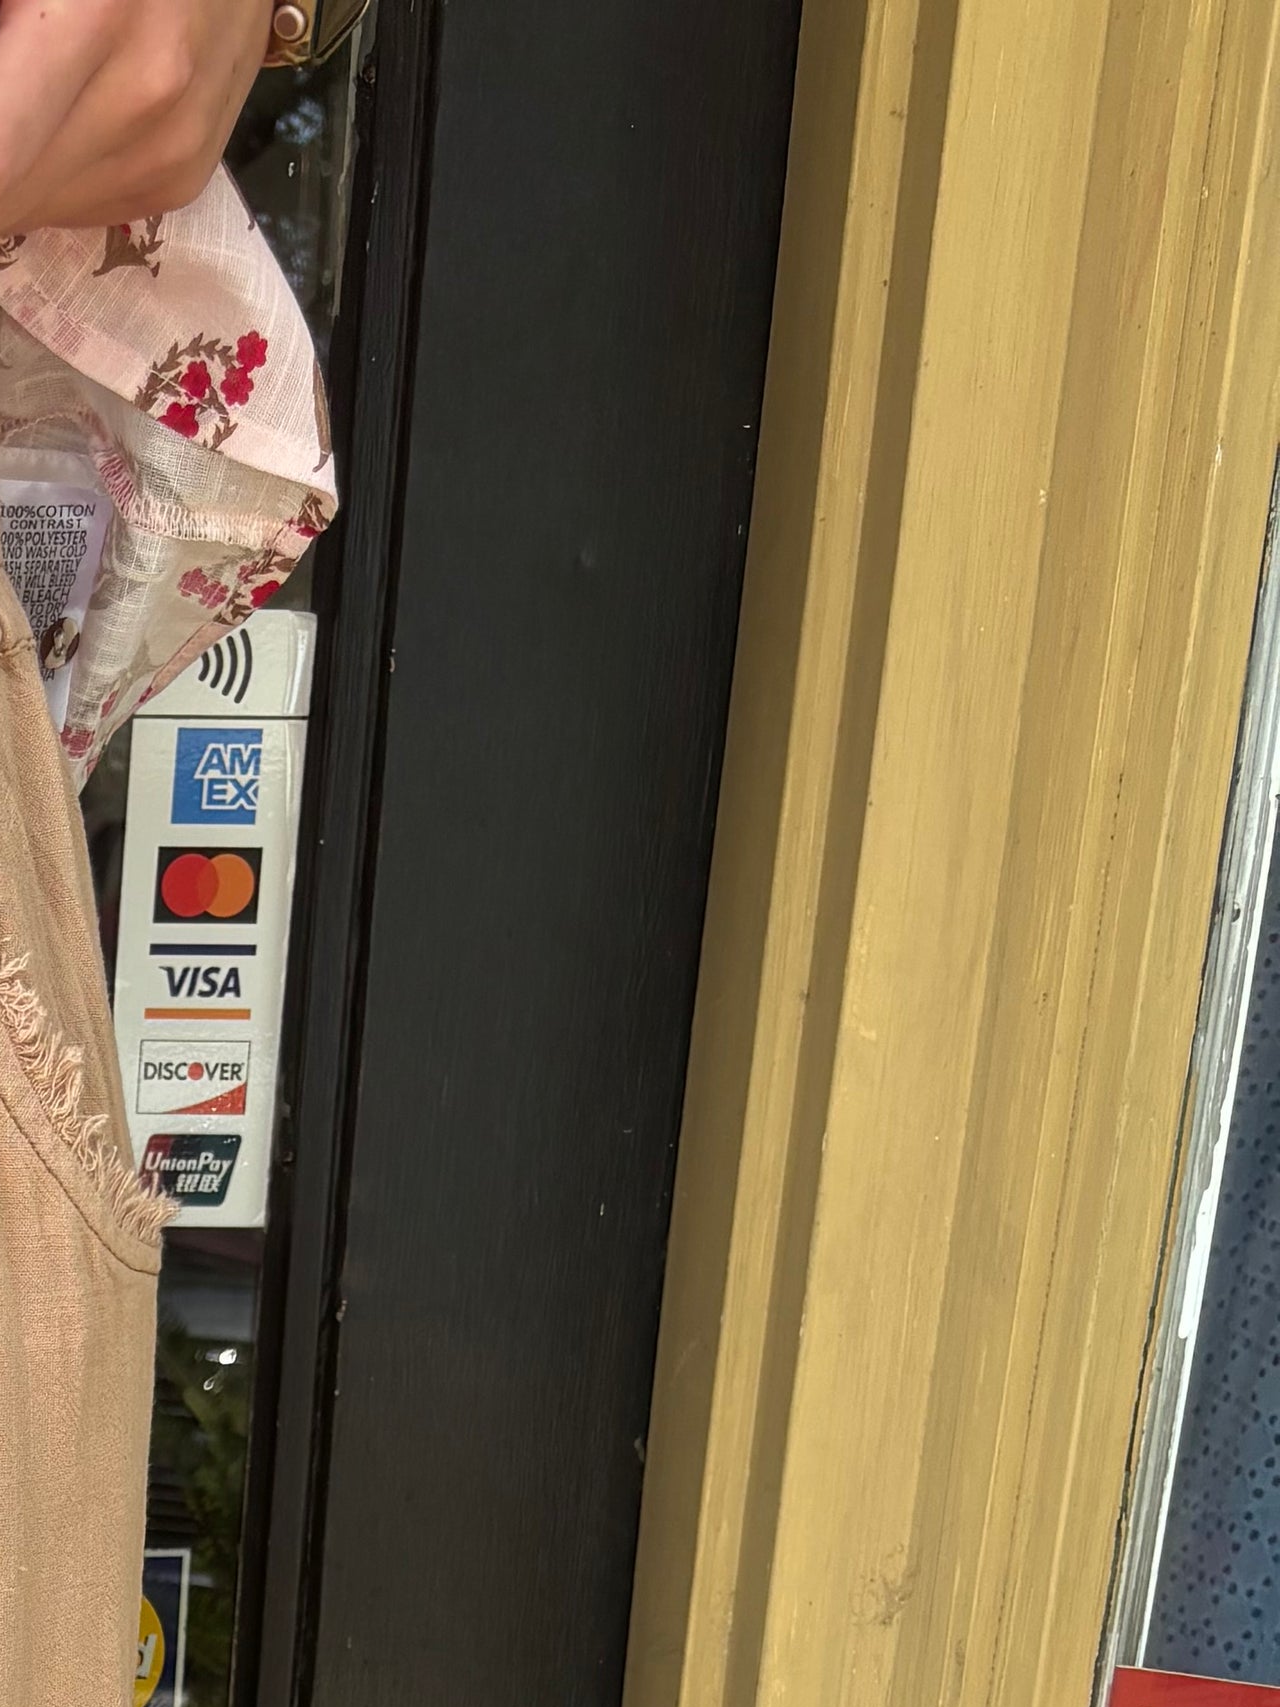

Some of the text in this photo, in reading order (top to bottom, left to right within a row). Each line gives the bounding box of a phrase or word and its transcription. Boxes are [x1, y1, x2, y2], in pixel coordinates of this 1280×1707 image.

[10, 519, 82, 530] CONTRAST
[0, 530, 87, 546] 00%POLYESTER
[25, 546, 57, 559] WASH
[60, 544, 87, 558] COLD
[24, 558, 82, 575] SEPARATELY
[23, 587, 70, 603] BLEACH
[30, 602, 68, 617] TO DRY
[193, 743, 263, 779] AM
[201, 776, 259, 810] EX
[158, 966, 241, 998] VISA
[143, 1061, 243, 1081] DISCOVER
[145, 1151, 232, 1180] UnionPay
